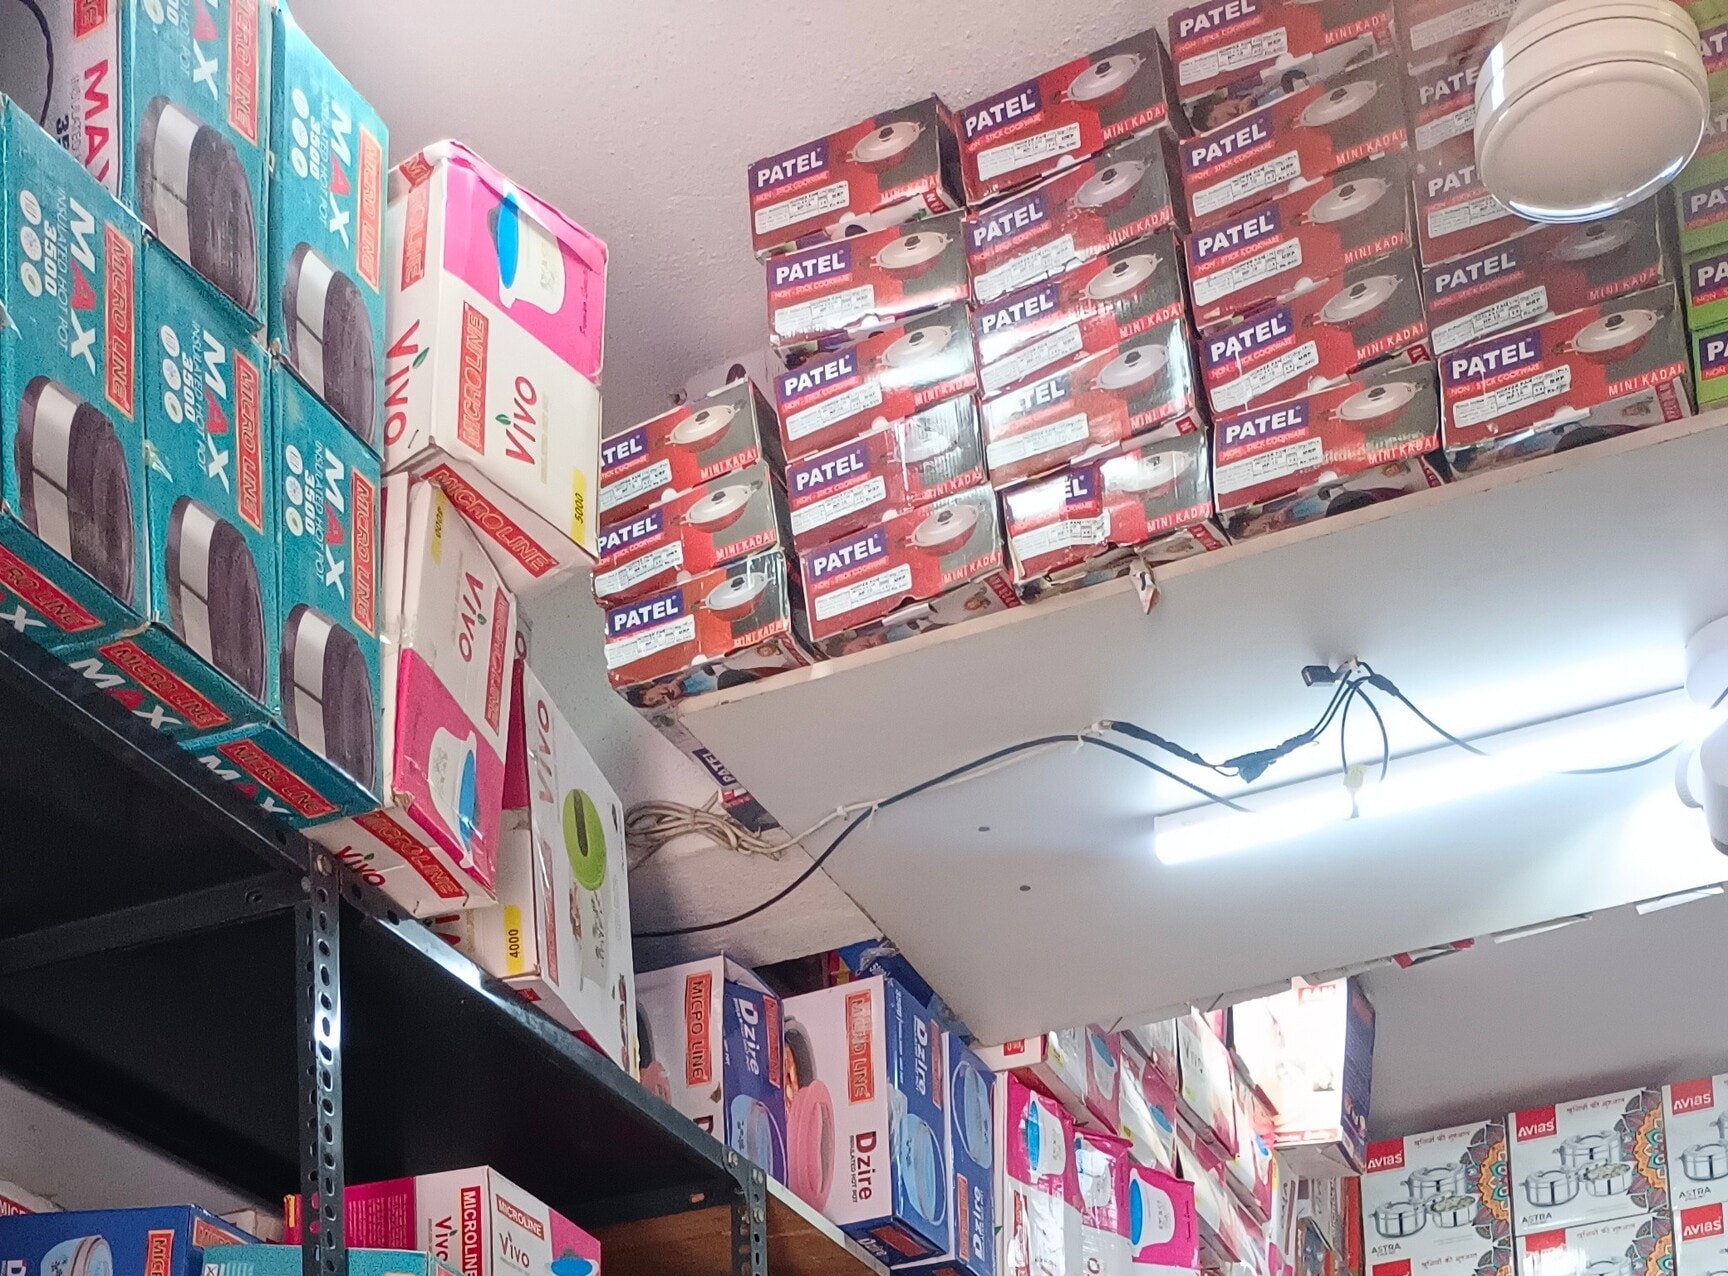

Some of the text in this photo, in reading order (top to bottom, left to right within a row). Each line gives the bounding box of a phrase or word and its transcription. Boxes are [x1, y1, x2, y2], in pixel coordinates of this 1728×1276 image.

[966, 93, 1037, 137] PATEL
[328, 104, 352, 247] MAX
[758, 151, 824, 188] PATEL
[973, 202, 1045, 244] PATEL
[43, 224, 57, 296] 3500
[776, 252, 845, 284] PATEL
[108, 241, 133, 406] MICRO LINE
[982, 295, 1054, 333] PATEL
[1211, 319, 1287, 361] PATEL
[1357, 323, 1425, 361] MINI KADAI
[386, 320, 418, 447] Vivo
[784, 357, 853, 395] PATEL
[202, 328, 230, 493] MAX
[701, 450, 757, 479] MINI KADAI
[797, 452, 865, 490] PATEL
[303, 472, 315, 536] 3500
[572, 493, 585, 524] 5000
[322, 448, 346, 600] MAX
[716, 531, 775, 559] MINI KADAI
[615, 599, 679, 633] PATEL
[71, 658, 181, 730] MAX
[508, 928, 521, 959] 4000
[854, 1131, 878, 1201] Dzire
[1679, 1187, 1711, 1199] ASTRA
[500, 1231, 530, 1269] Vivo
[1371, 1243, 1401, 1254] ASTRA
